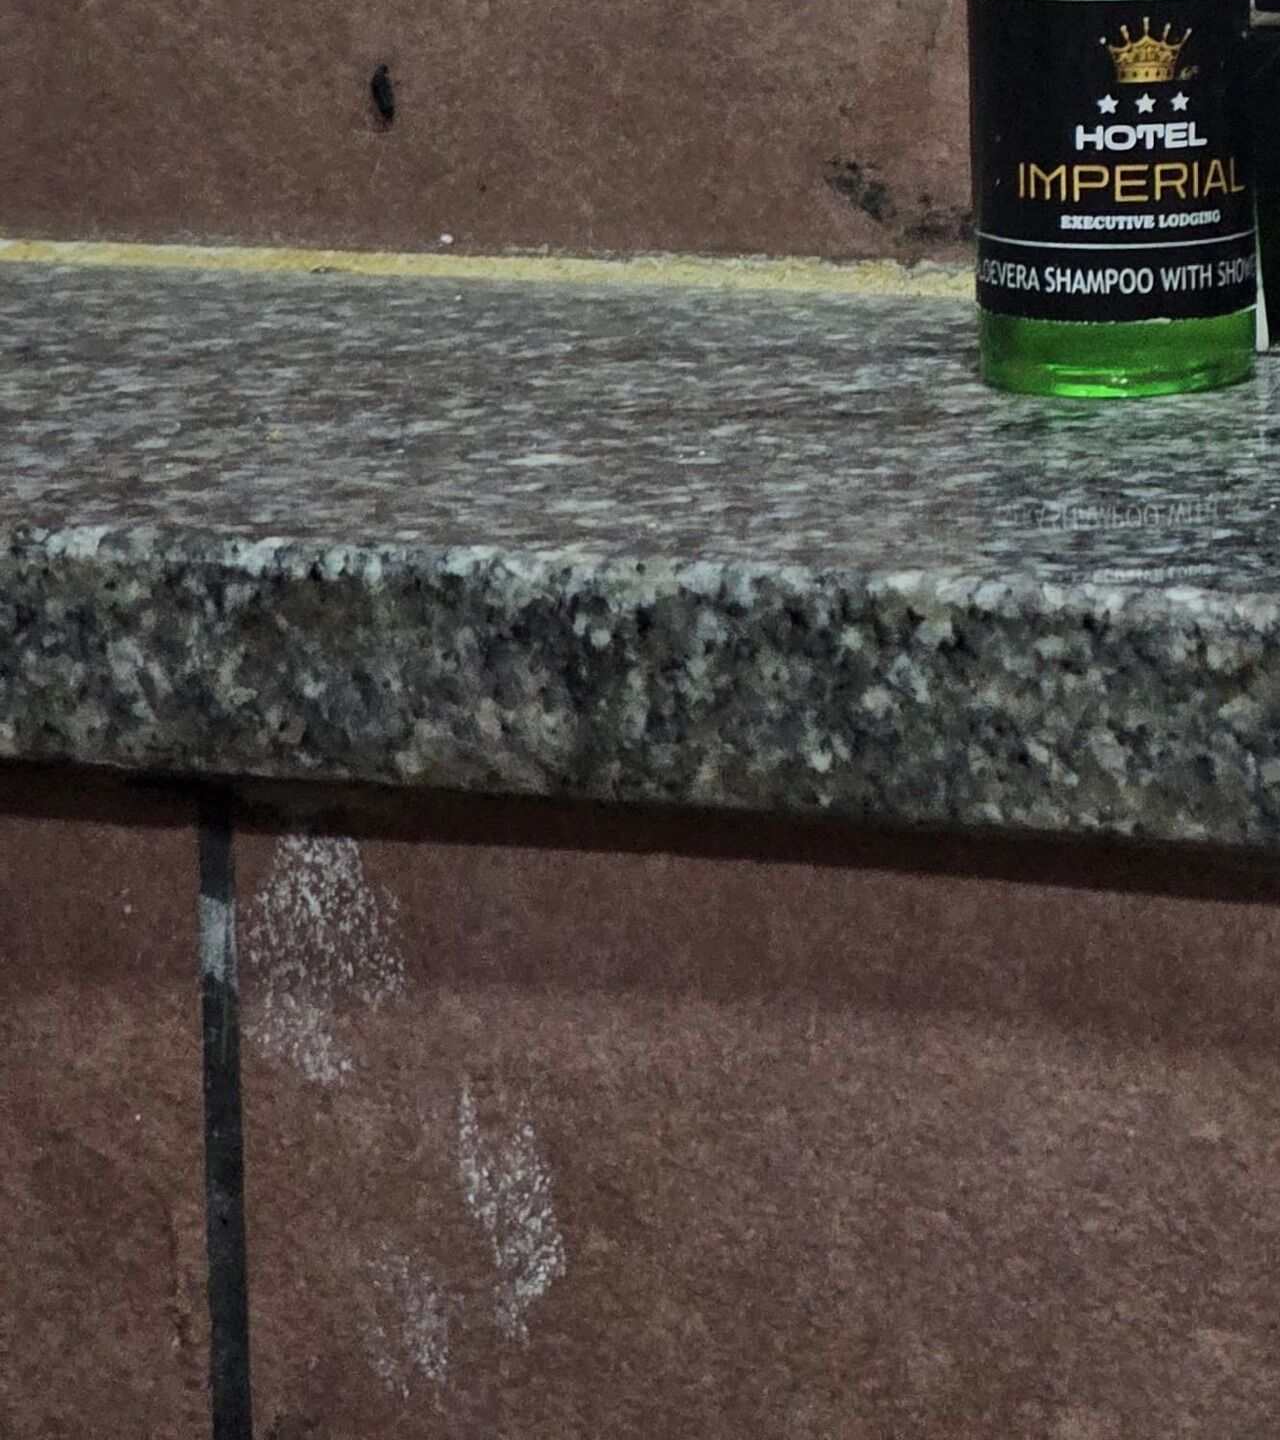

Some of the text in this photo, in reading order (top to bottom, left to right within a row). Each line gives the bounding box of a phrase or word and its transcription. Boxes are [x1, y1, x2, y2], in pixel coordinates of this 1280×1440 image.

[1075, 121, 1208, 151] HOTEL
[1017, 157, 1246, 203] IMPERIAL
[1060, 209, 1221, 231] EXECUTIVE LODGING
[1044, 266, 1154, 294] SHAMPOO
[1160, 263, 1212, 291] WITH
